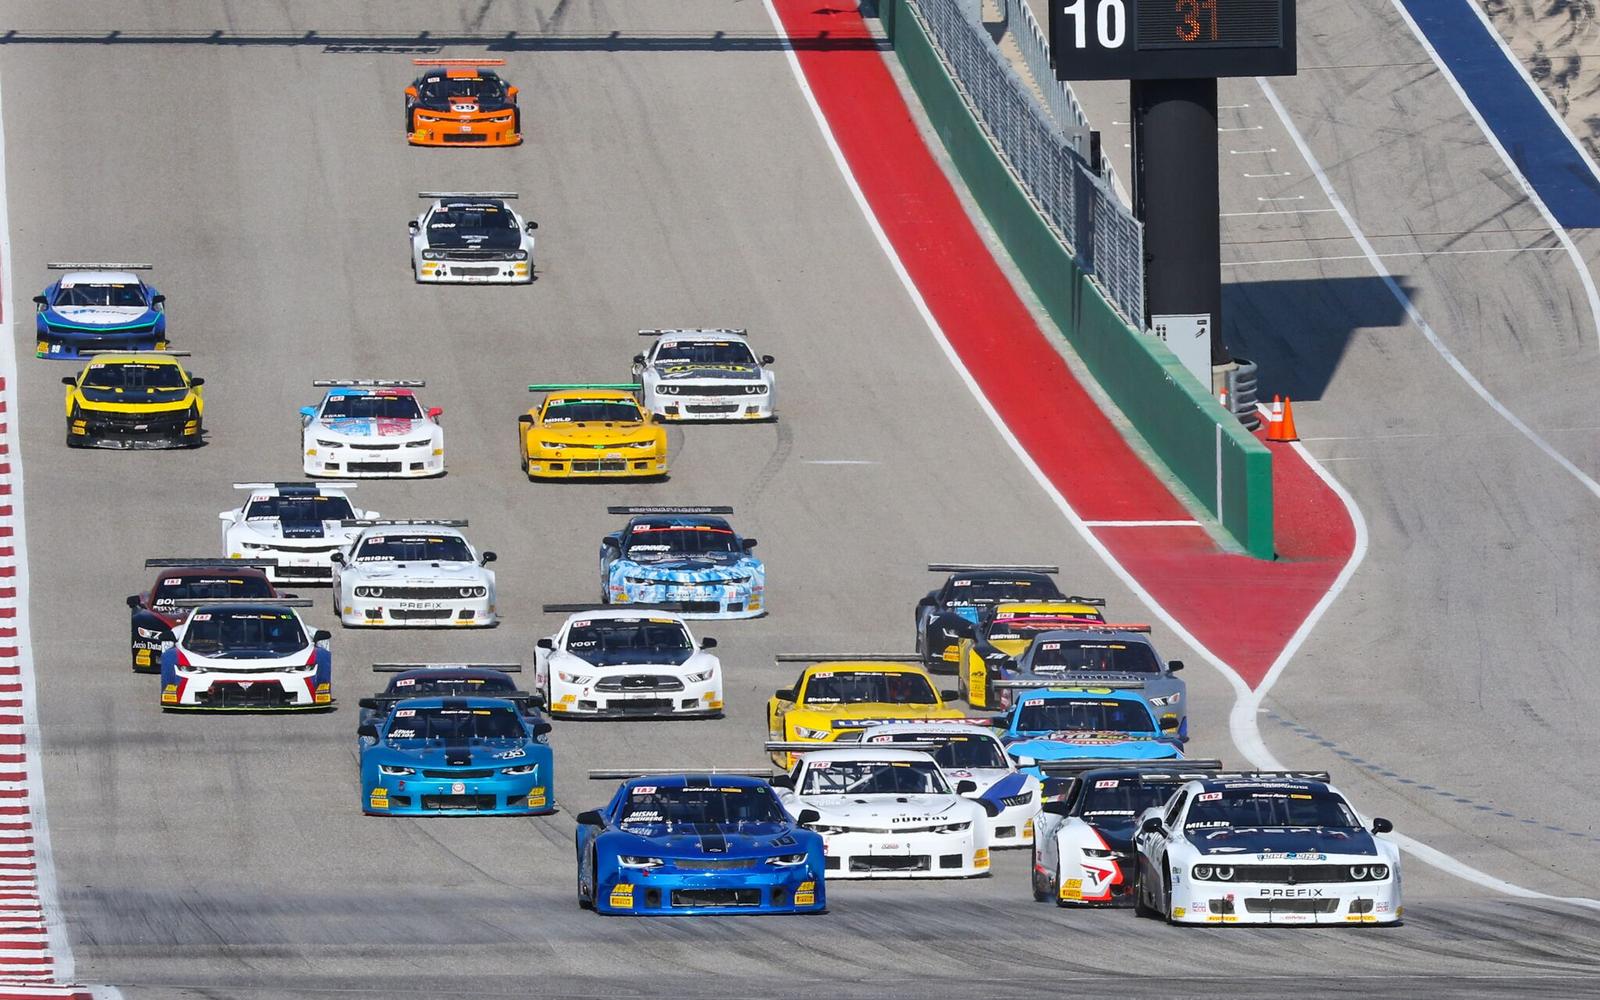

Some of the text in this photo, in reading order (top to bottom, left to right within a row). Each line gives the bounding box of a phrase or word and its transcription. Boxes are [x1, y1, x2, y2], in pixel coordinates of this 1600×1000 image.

[1064, 0, 1126, 49] 10
[1176, 0, 1220, 41] 31
[628, 544, 671, 552] SKINNER
[570, 640, 597, 648] VOGT
[1201, 793, 1220, 801] TA2
[891, 816, 949, 824] DUNTOV
[1185, 821, 1230, 829] MILLER
[1260, 888, 1323, 898] PREFIX
